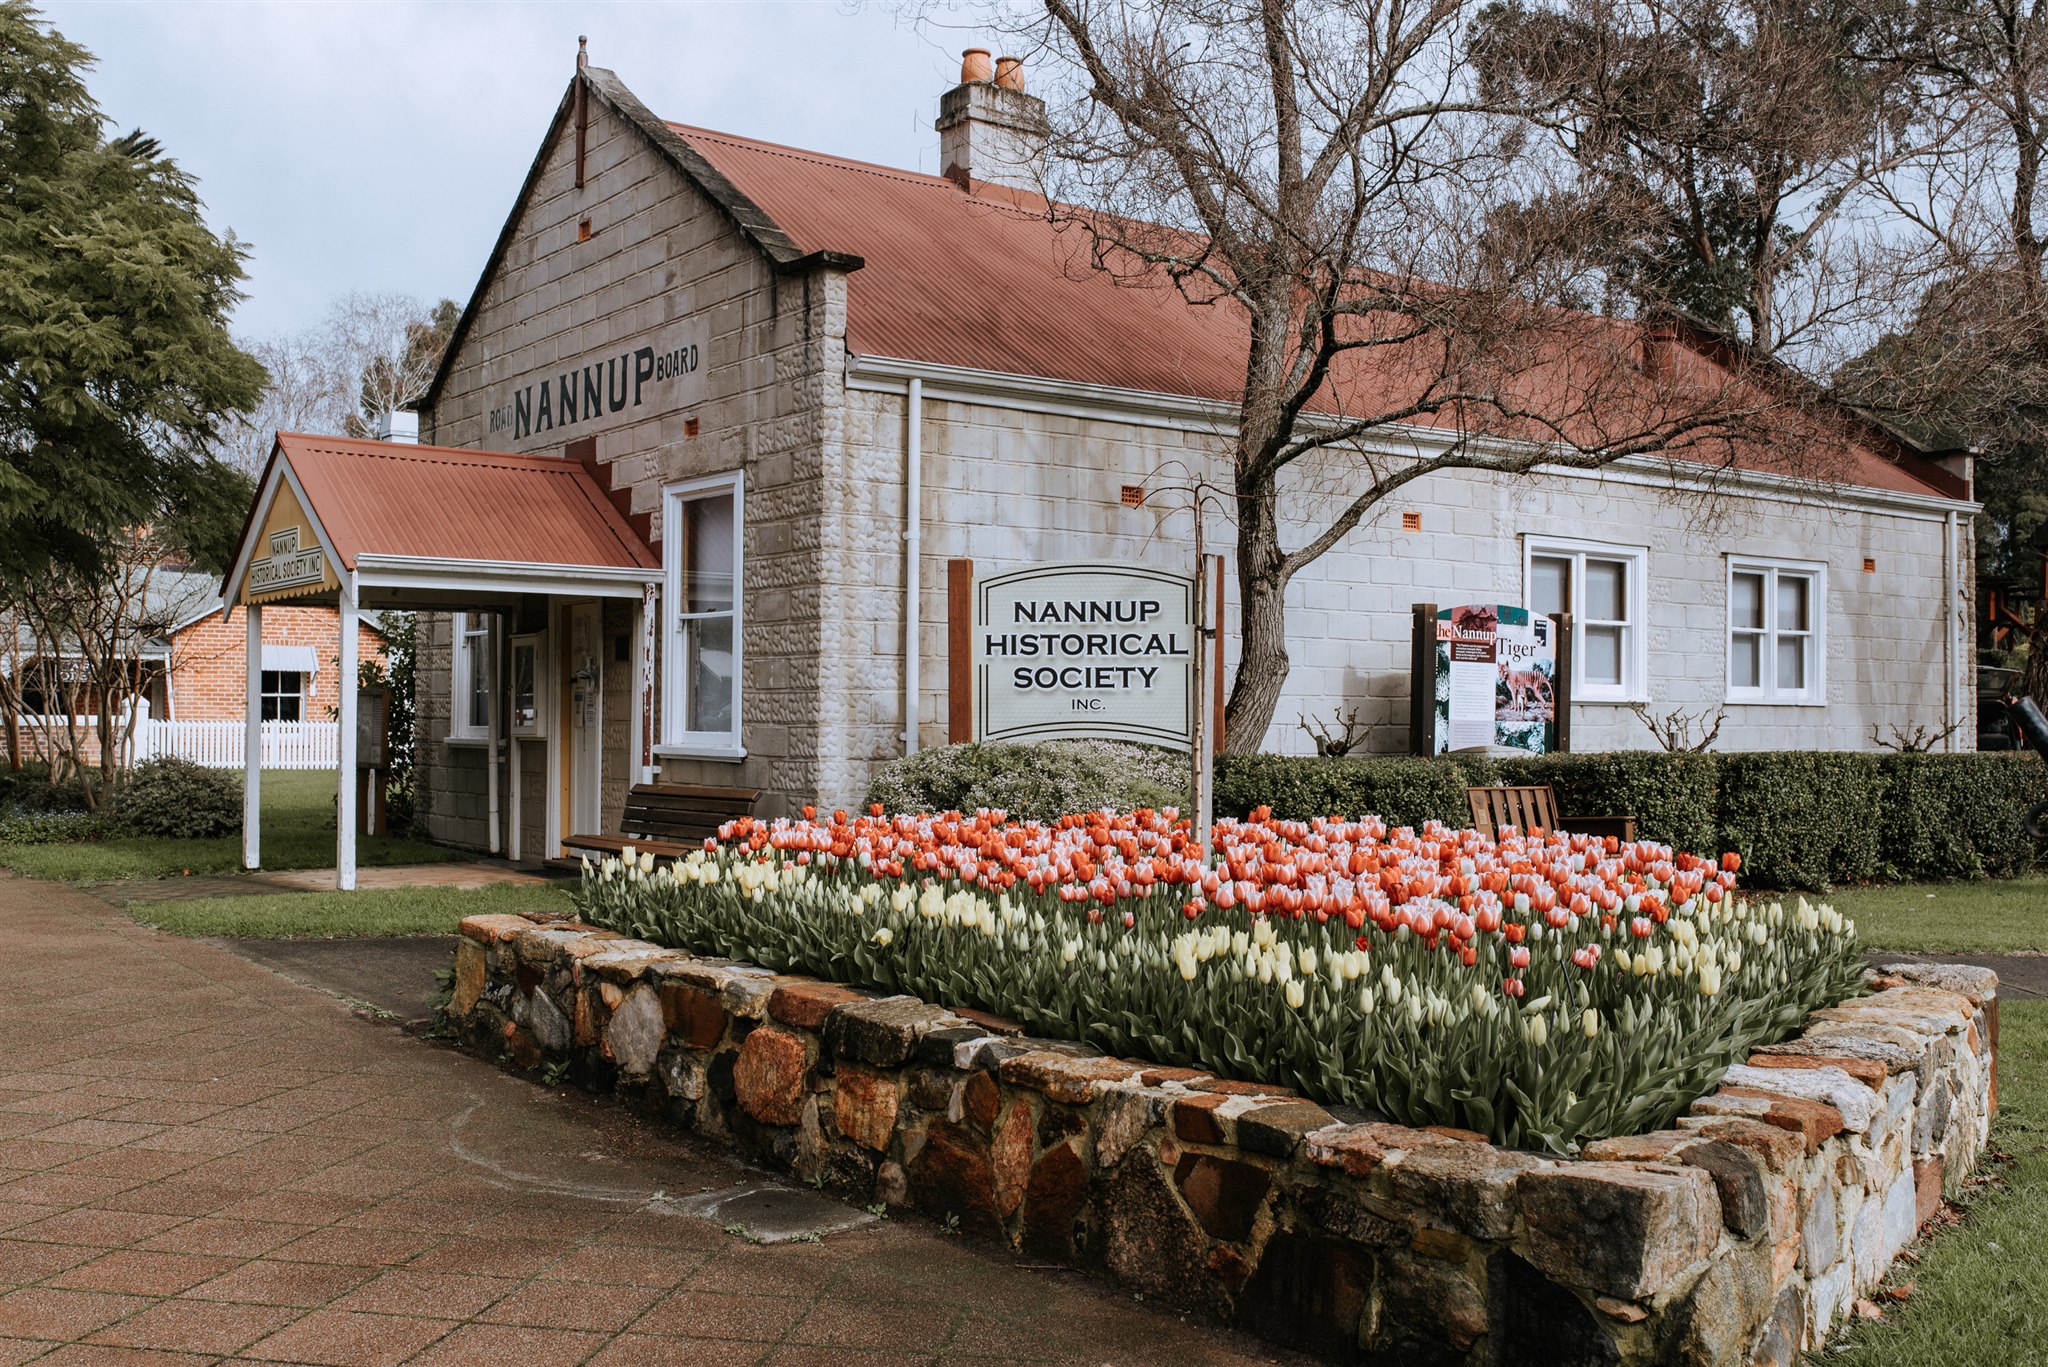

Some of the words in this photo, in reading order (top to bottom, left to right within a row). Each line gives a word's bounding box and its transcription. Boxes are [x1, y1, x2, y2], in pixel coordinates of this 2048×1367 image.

[489, 404, 513, 433] ROAD
[513, 346, 655, 441] NANNUP
[656, 344, 698, 382] BOARD
[272, 536, 296, 557] NANNUP
[251, 562, 282, 585] HISTORICAL
[282, 558, 308, 579] SOCIETY
[308, 554, 320, 574] INC
[1013, 600, 1160, 623] NANNUP
[985, 633, 1189, 656] HISTORICAL
[1437, 624, 1450, 638] he
[1452, 625, 1496, 645] Nannup
[1497, 637, 1536, 662] Tiger
[1013, 666, 1159, 689] SOCIETY
[1071, 698, 1106, 711] INC.
